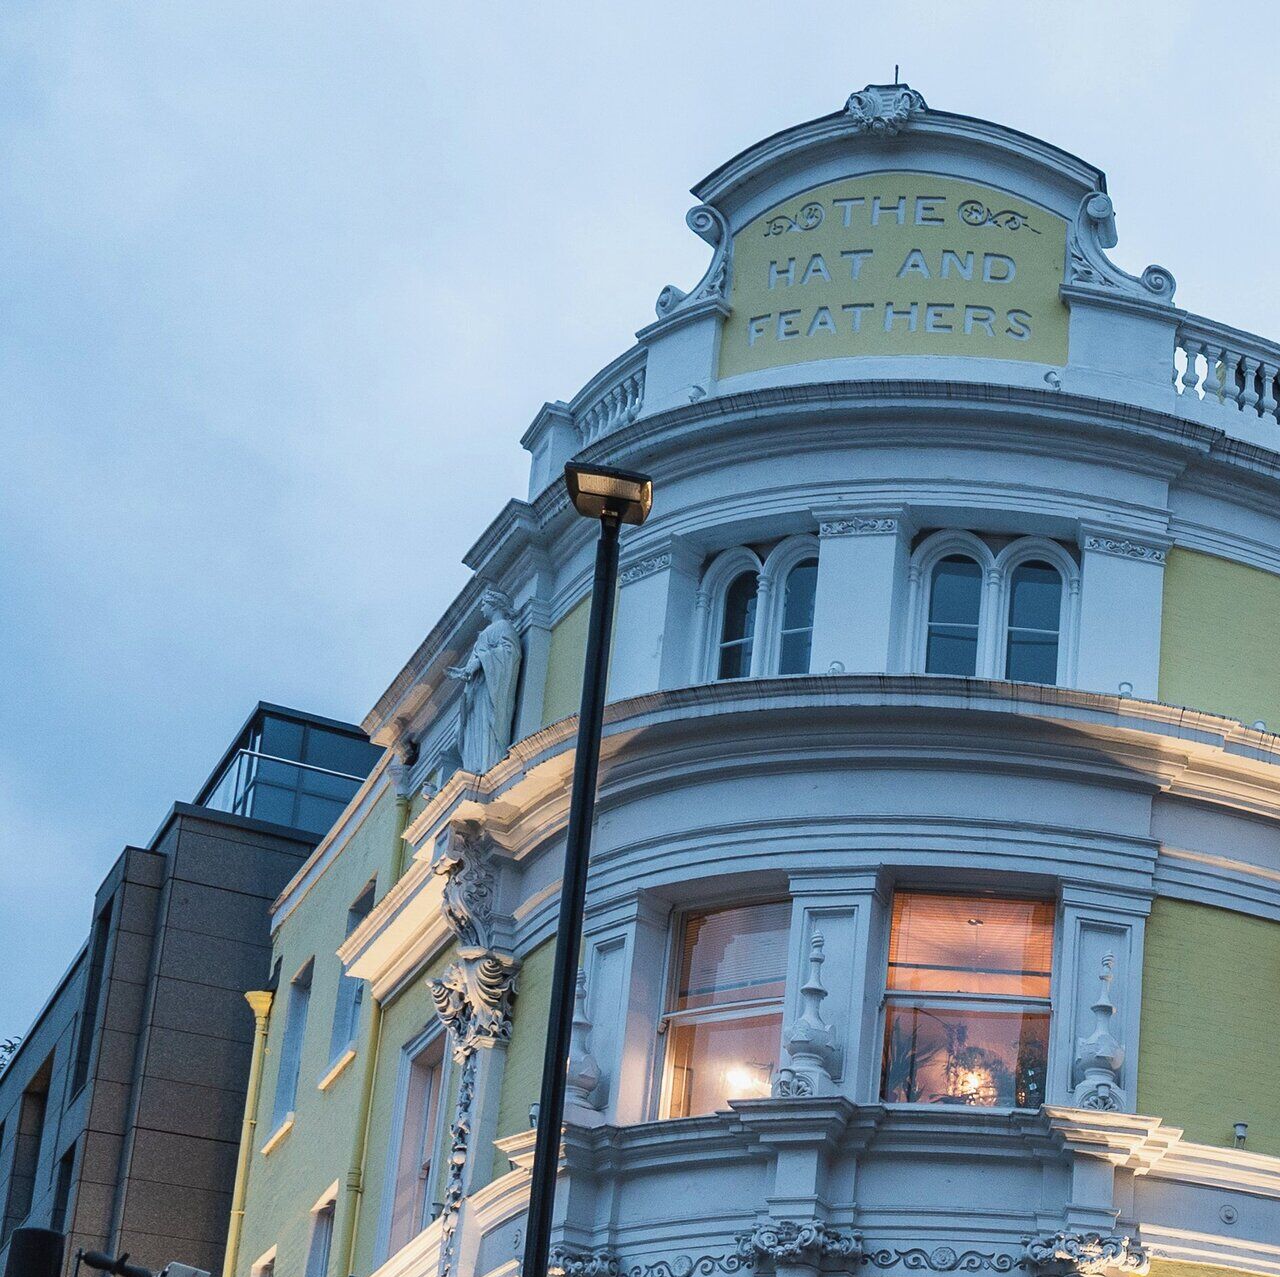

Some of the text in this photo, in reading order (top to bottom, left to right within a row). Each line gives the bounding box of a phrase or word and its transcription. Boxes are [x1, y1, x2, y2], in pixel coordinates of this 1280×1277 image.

[832, 195, 948, 227] THE
[768, 248, 1017, 290] HAT AND
[747, 301, 1034, 347] FEATHERS
